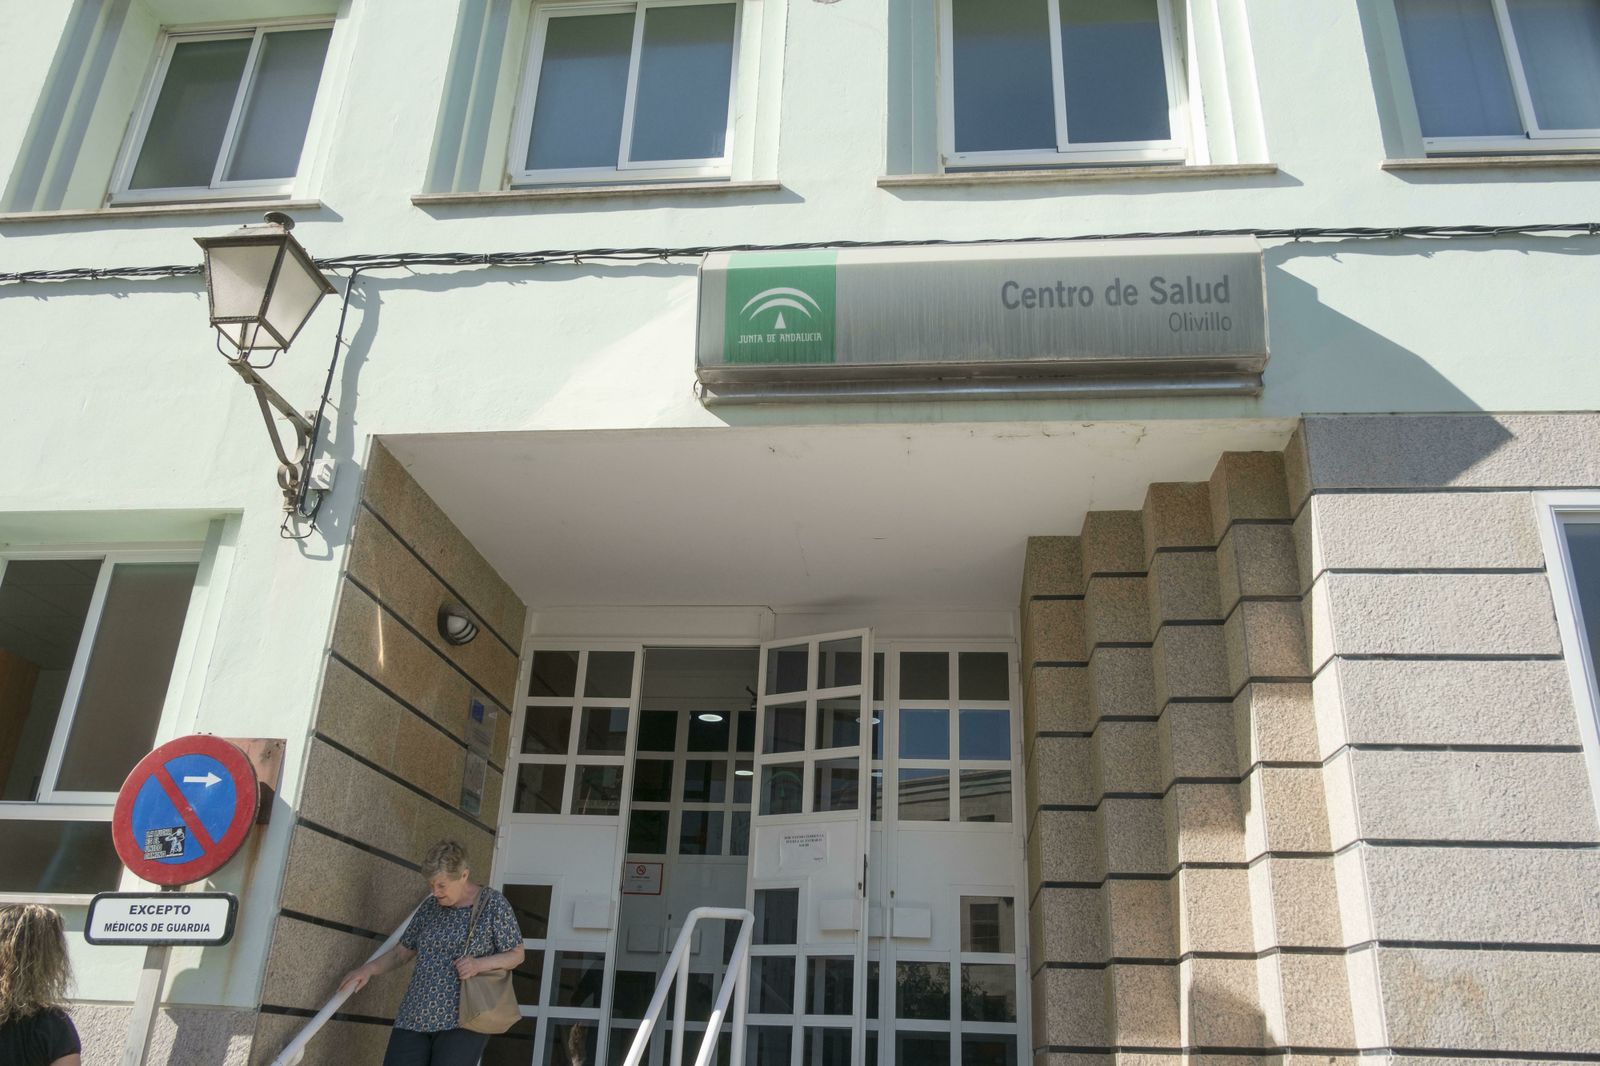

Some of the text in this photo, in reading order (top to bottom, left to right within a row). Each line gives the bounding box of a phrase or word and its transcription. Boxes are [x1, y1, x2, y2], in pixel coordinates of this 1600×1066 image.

[1001, 274, 1231, 310] Centro de Salud
[1168, 312, 1232, 333] Olivillo
[738, 334, 763, 344] JUNTA
[766, 334, 777, 343] DE
[129, 904, 191, 915] EXCEPTO
[104, 921, 210, 932] MÉDICOS DE GUARDIA
